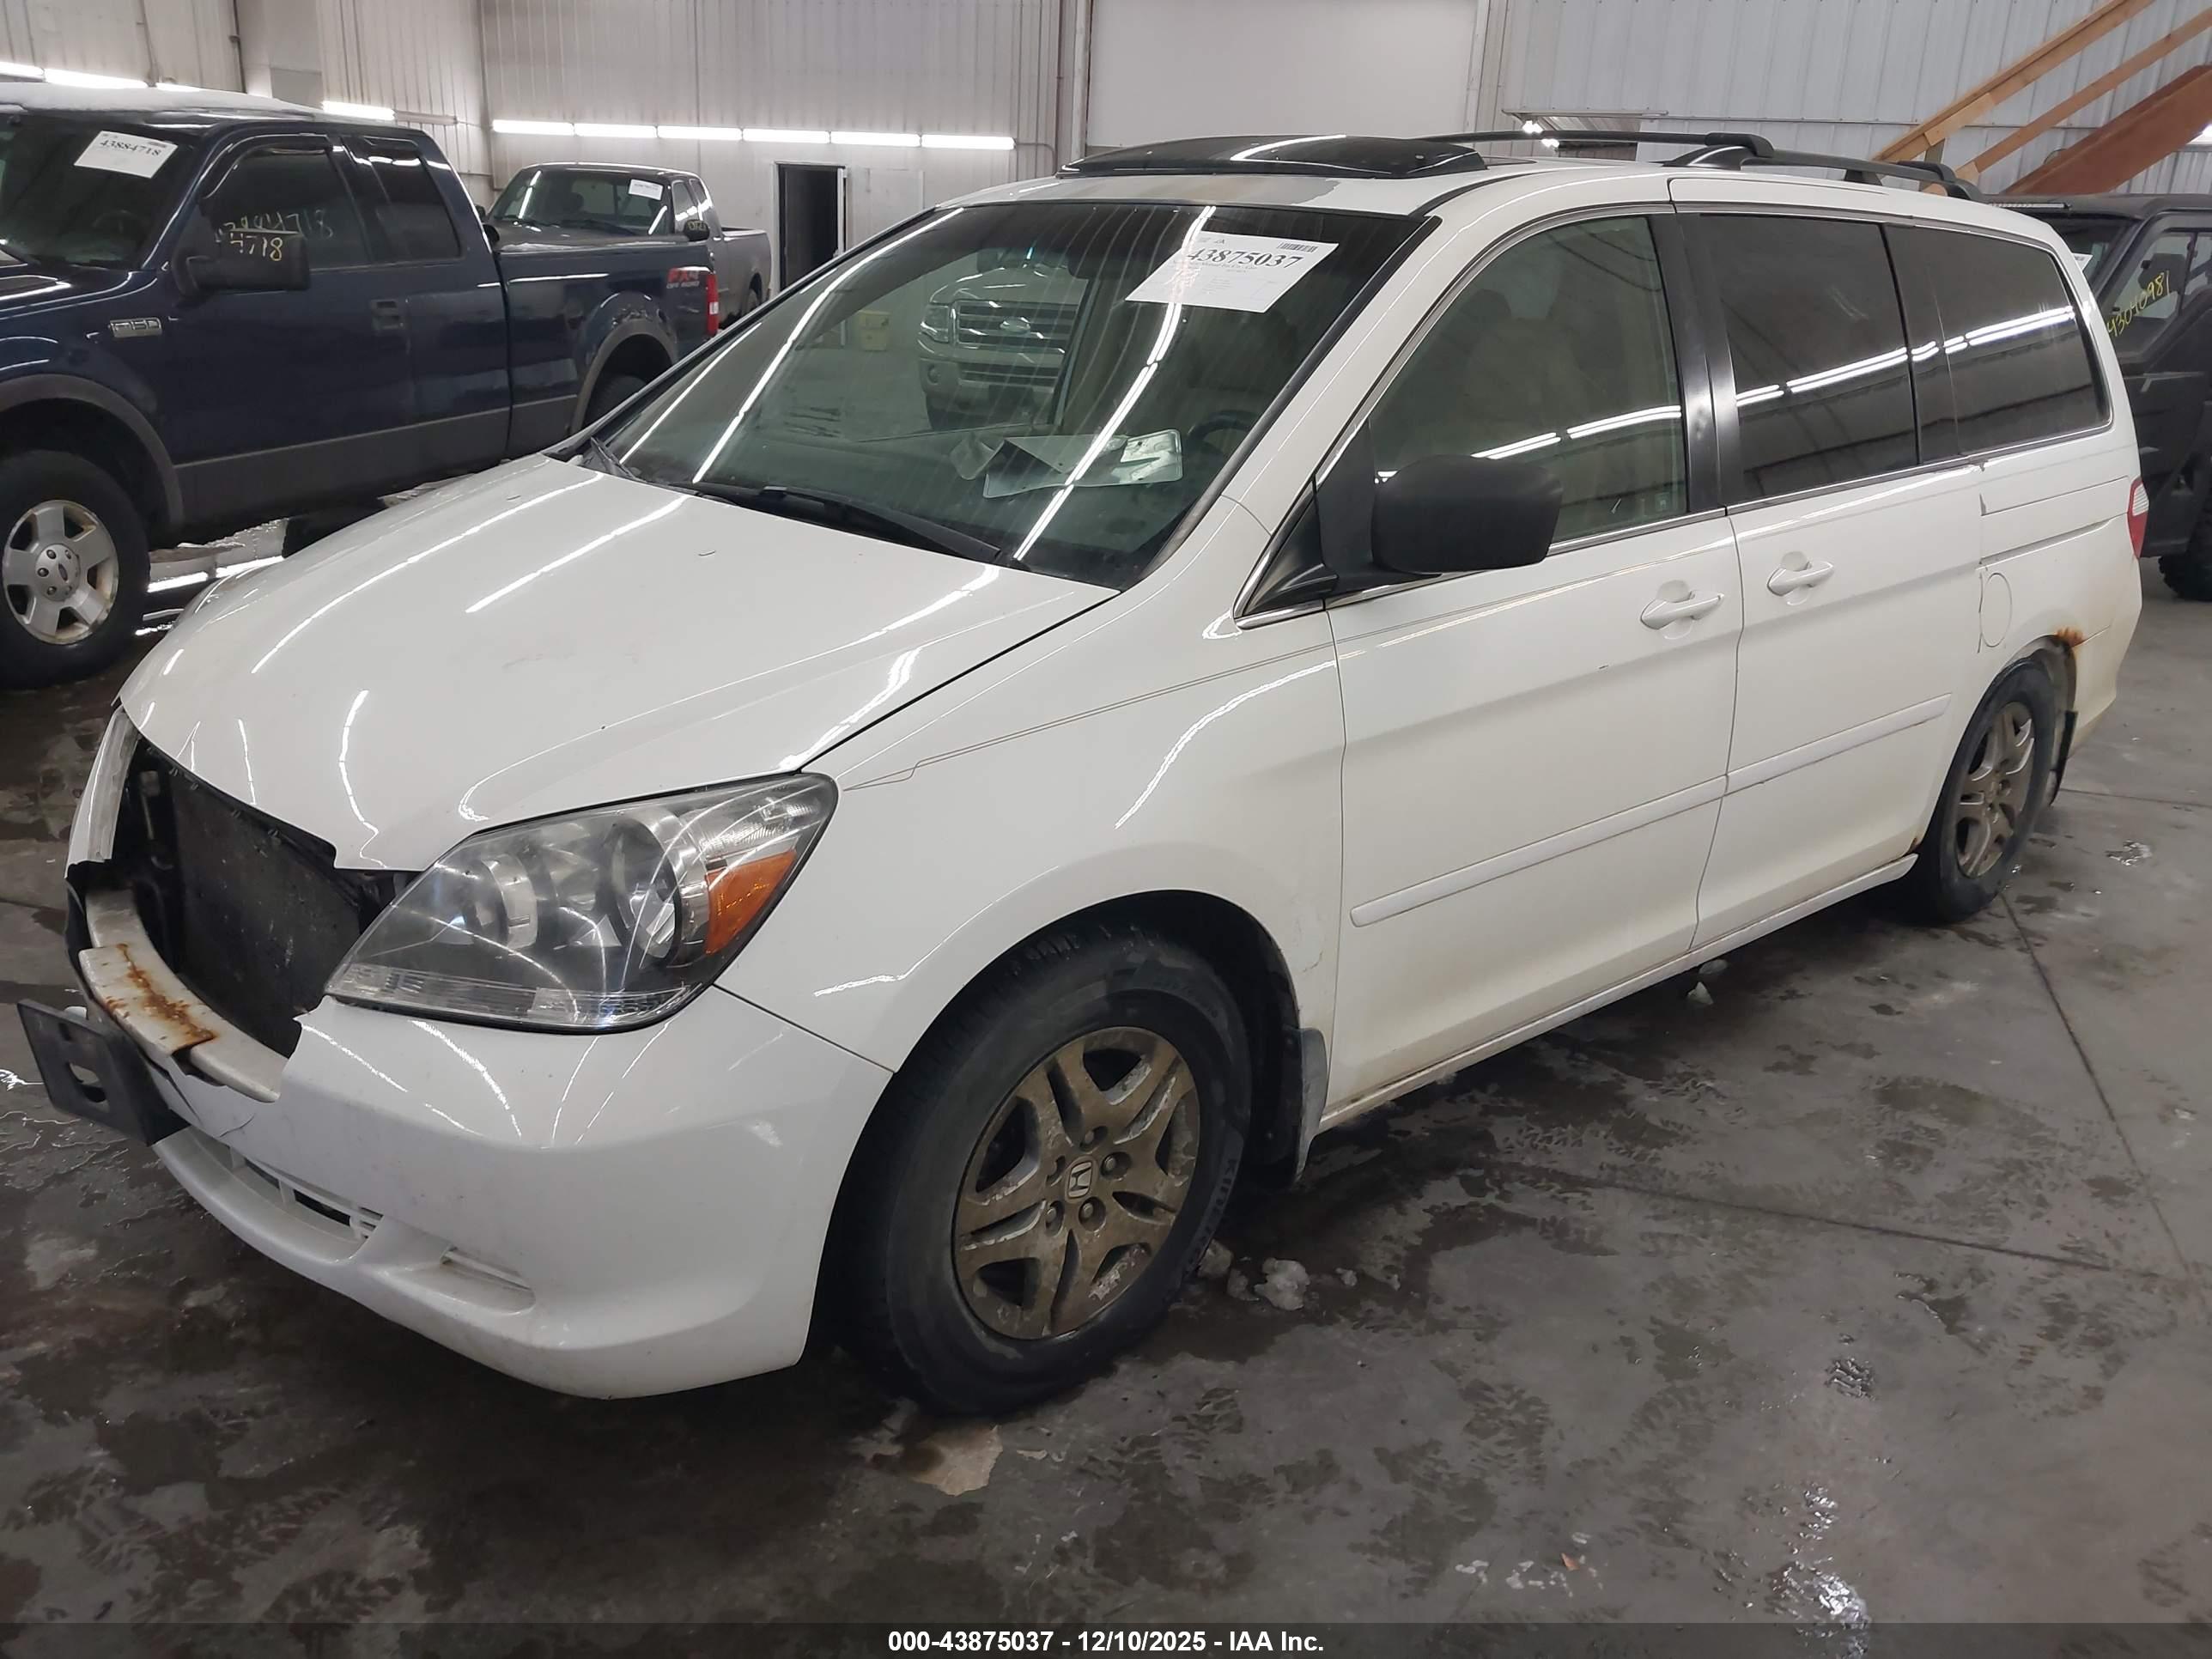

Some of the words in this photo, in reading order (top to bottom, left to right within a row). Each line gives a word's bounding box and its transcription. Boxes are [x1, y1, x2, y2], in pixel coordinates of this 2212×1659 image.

[100, 139, 162, 156] 43884718
[229, 233, 283, 262] 4718
[1187, 247, 1304, 269] 43875037
